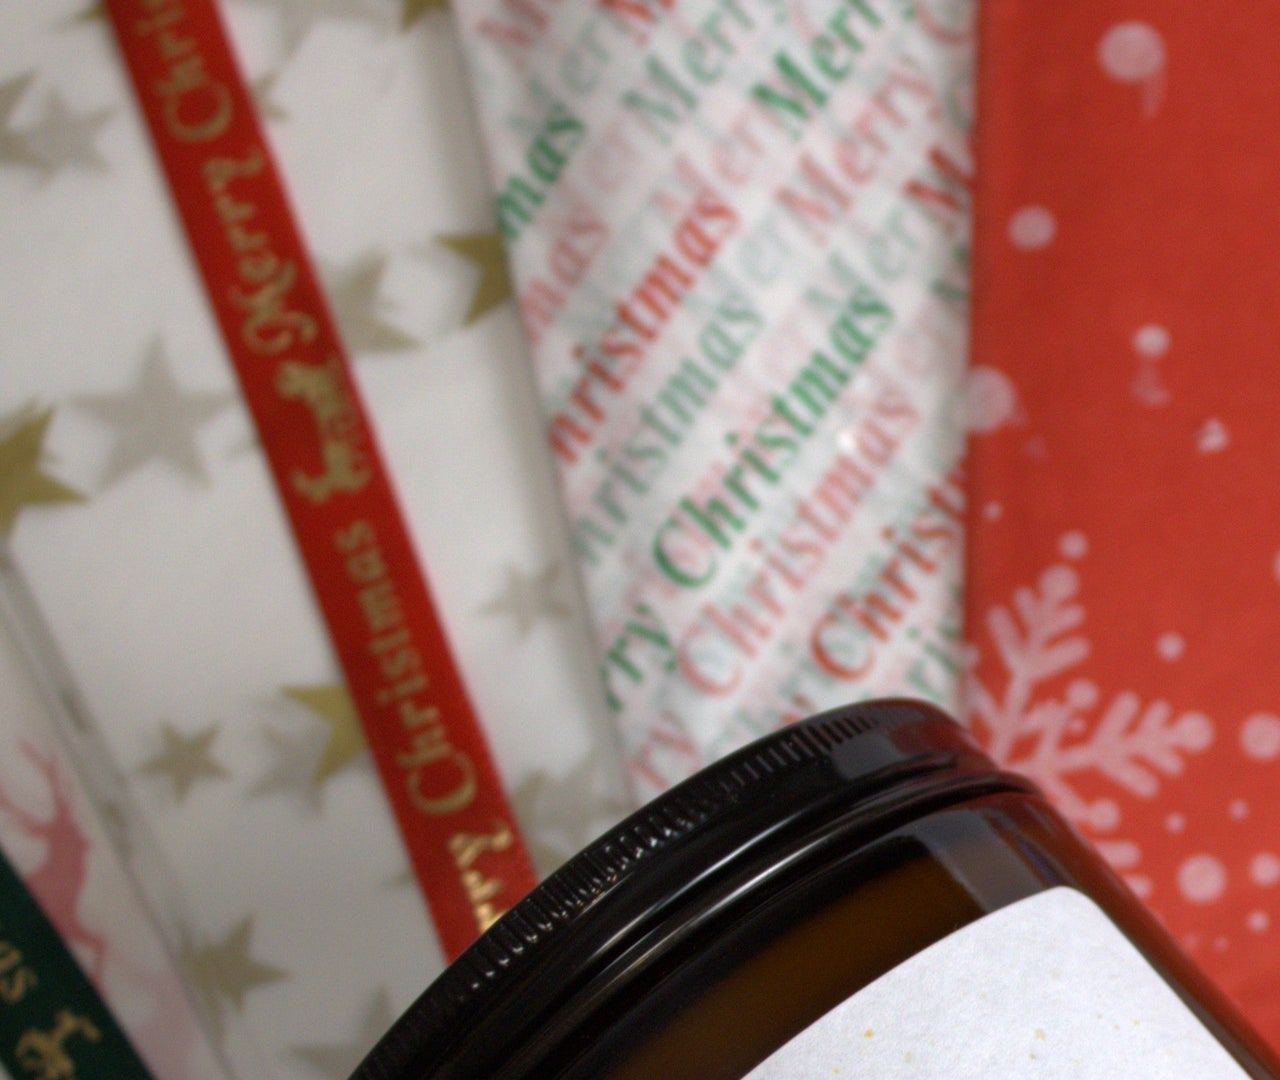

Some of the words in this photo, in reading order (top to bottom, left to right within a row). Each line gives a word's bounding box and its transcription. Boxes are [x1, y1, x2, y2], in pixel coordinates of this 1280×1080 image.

[653, 285, 894, 588] Christmas
[677, 385, 920, 697] Christmas
[335, 518, 478, 816] Christmas
